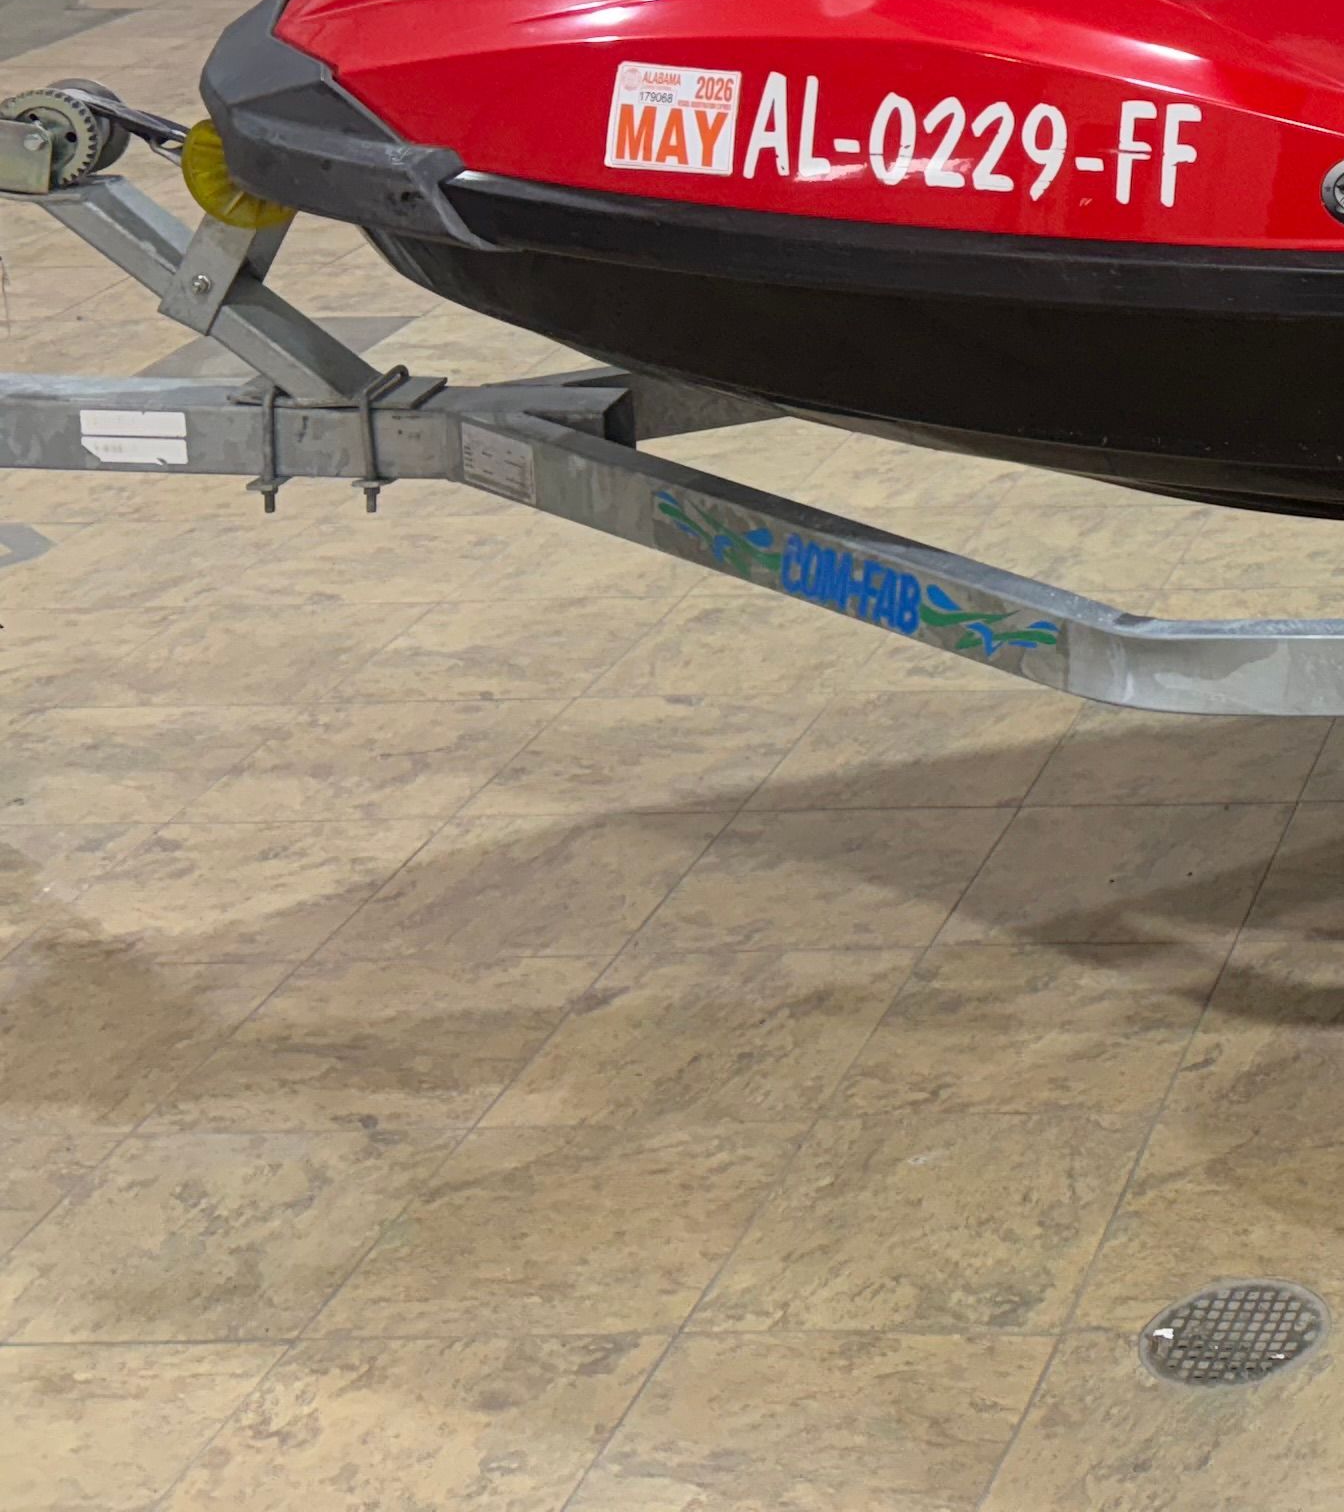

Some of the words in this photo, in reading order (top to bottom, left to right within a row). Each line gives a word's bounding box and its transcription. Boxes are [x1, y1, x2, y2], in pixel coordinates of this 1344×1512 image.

[643, 71, 681, 85] ALABAMA
[695, 76, 734, 101] 2026
[616, 103, 728, 167] MAY
[743, 71, 1202, 207] AL-0229-FF
[781, 533, 921, 635] COM-FAB
